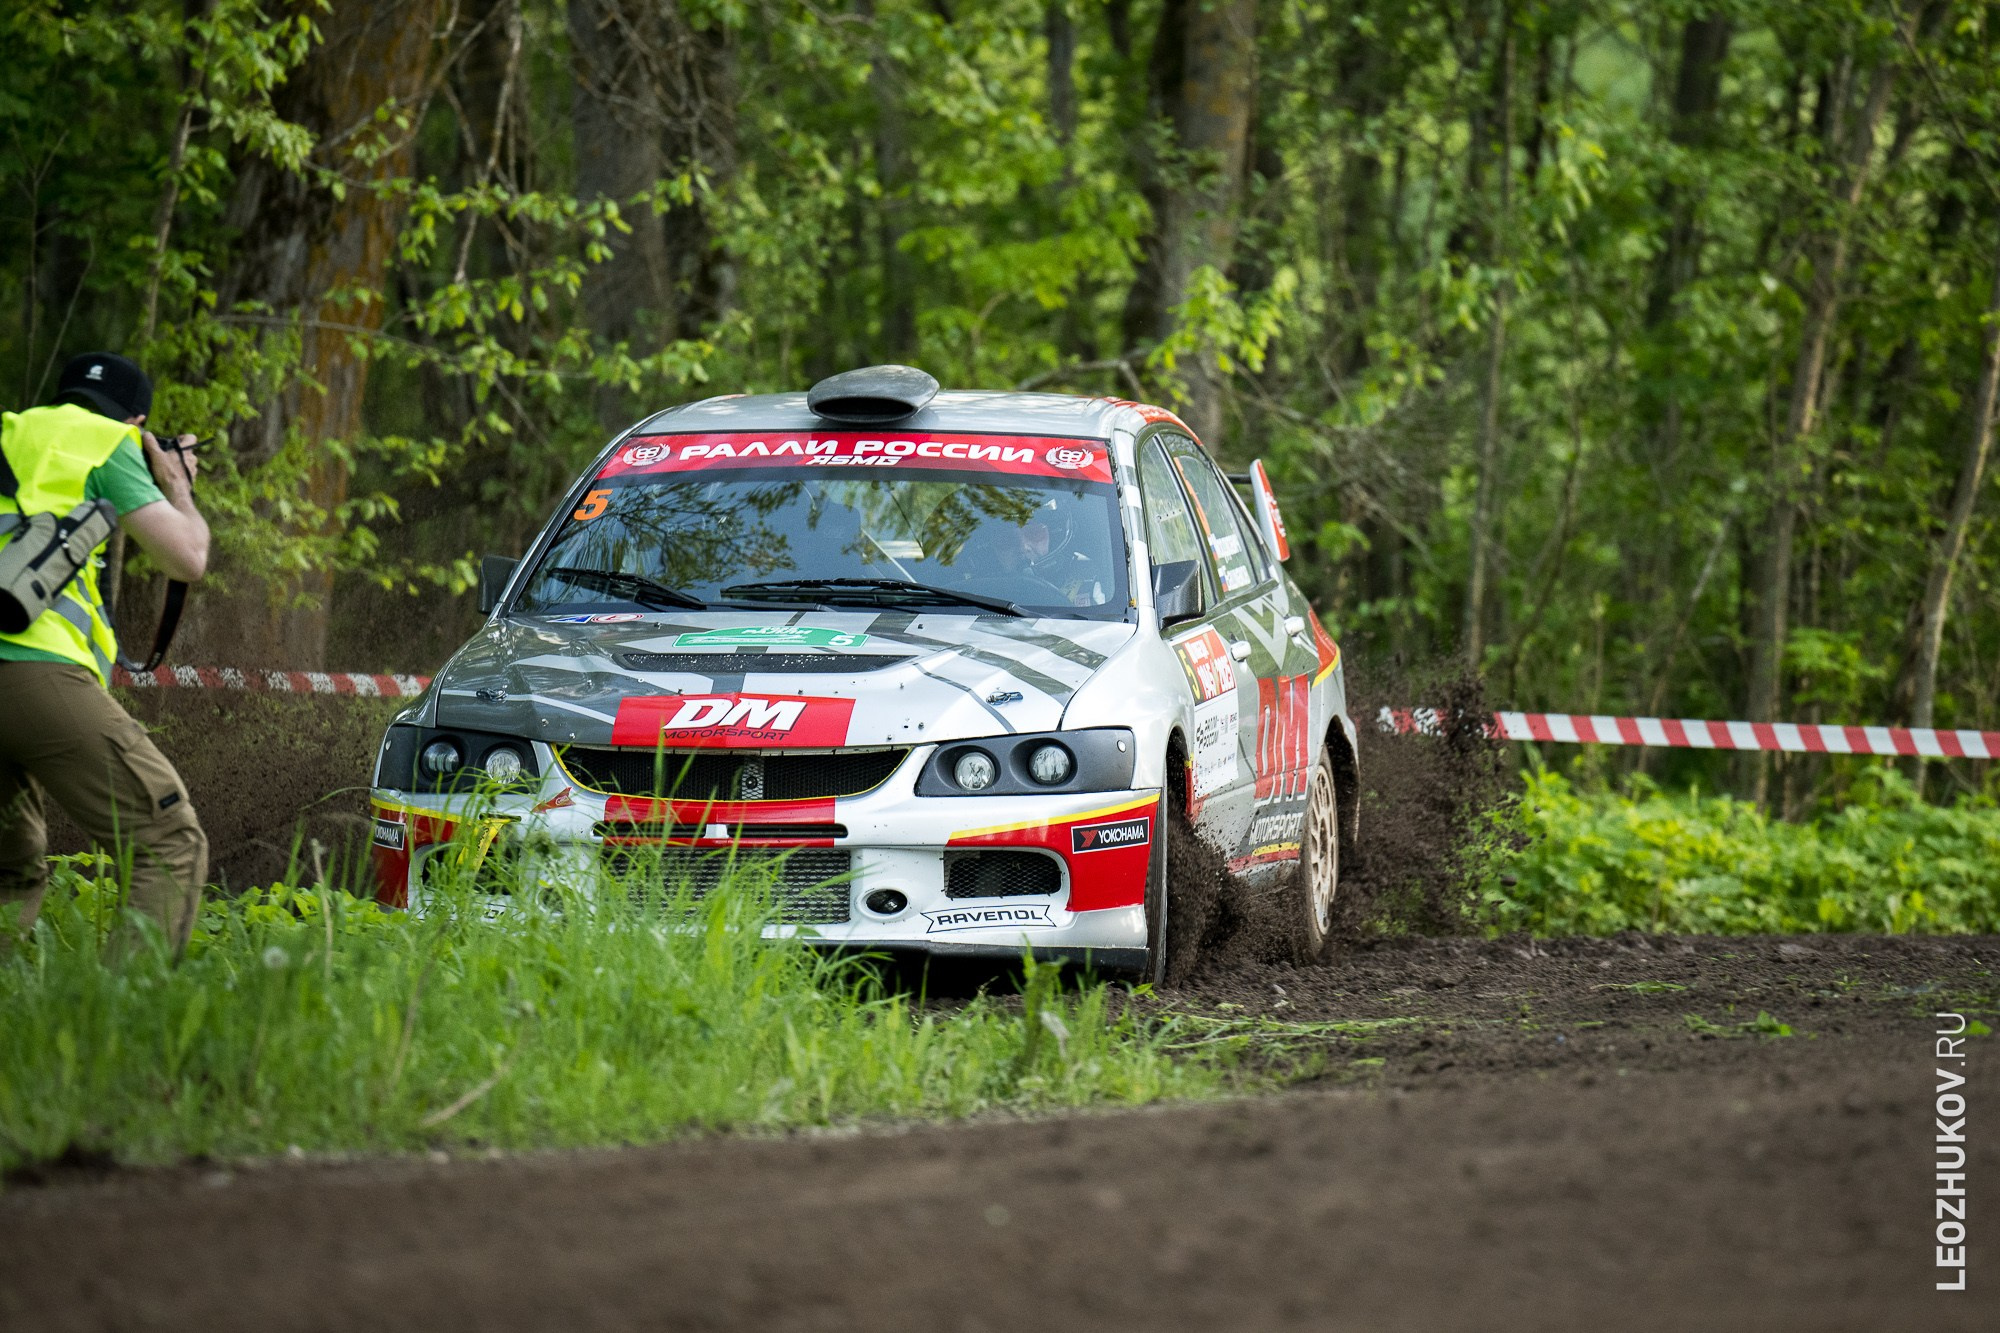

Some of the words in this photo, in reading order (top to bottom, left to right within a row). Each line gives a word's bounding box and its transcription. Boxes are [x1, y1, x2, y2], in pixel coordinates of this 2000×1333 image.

[679, 440, 838, 460] РАЛЛИ
[852, 440, 1034, 463] РОССИИ
[574, 489, 613, 520] 5
[828, 634, 856, 646] 5
[660, 697, 808, 731] DM
[662, 728, 790, 741] MOTORSPORT
[1253, 675, 1312, 807] DM
[1098, 825, 1145, 844] YOKOHAMA
[1248, 812, 1304, 846] MOTORSPORT
[936, 909, 1043, 926] RAVENOL
